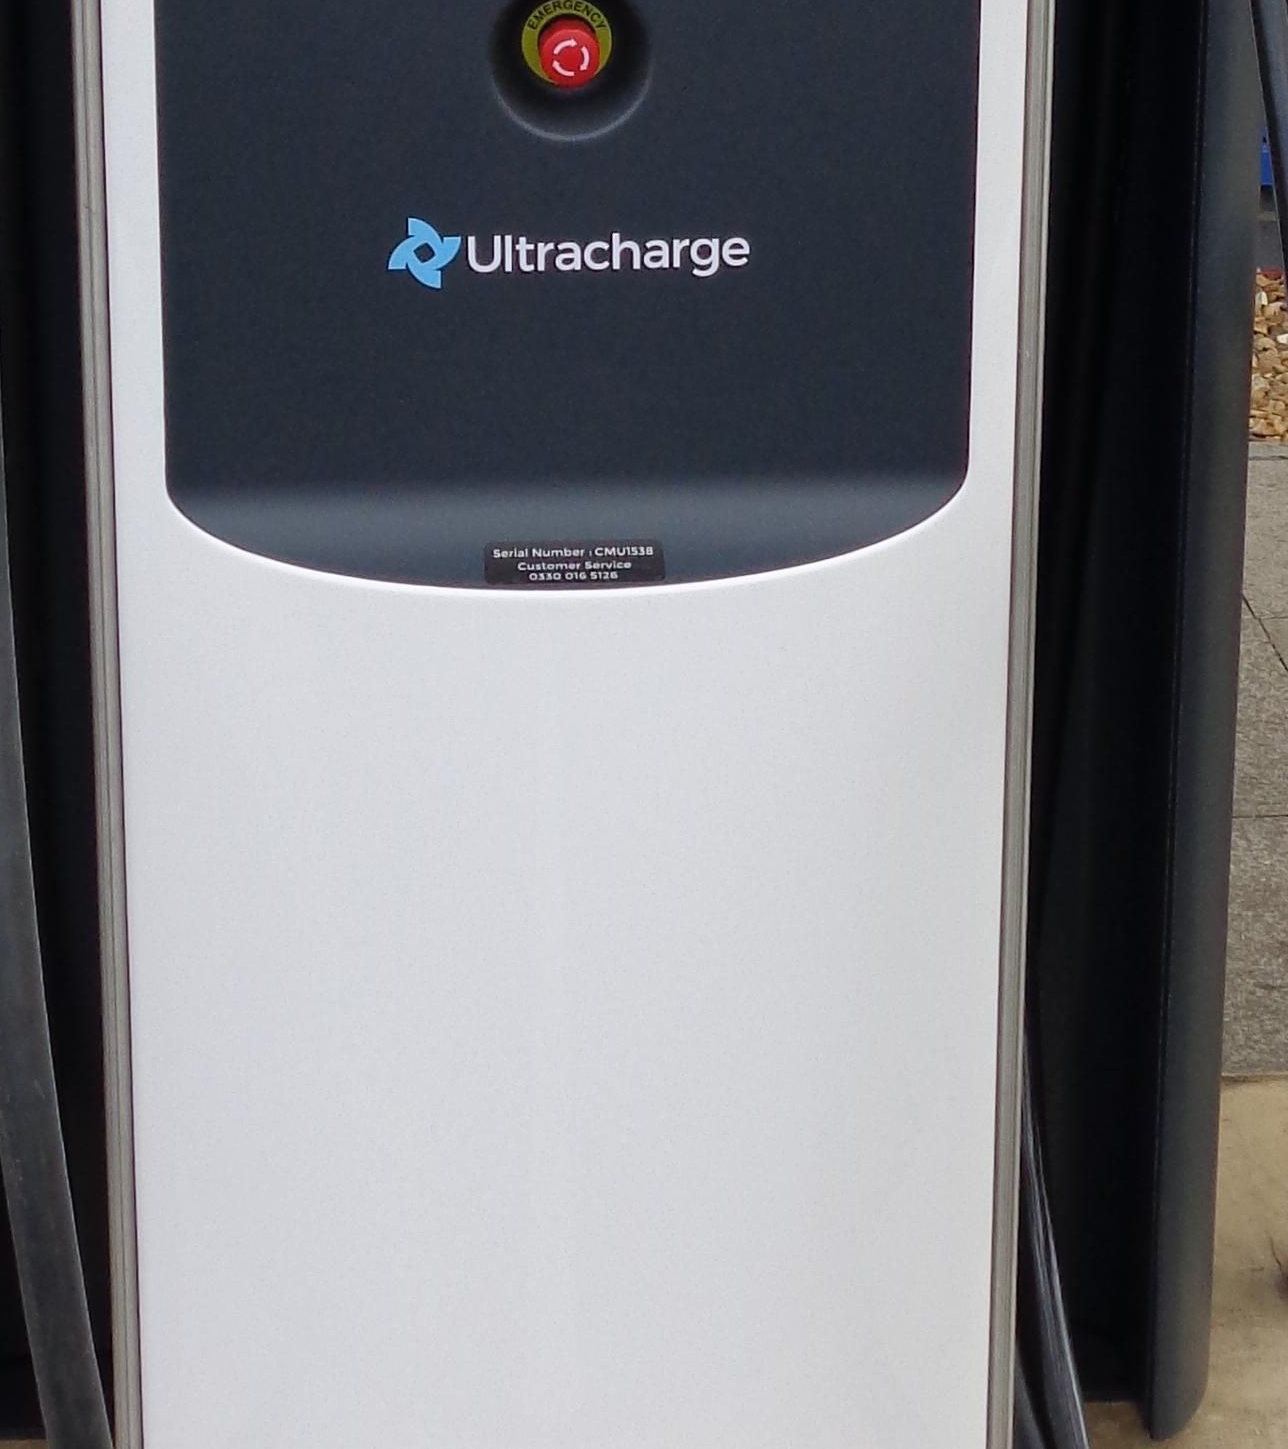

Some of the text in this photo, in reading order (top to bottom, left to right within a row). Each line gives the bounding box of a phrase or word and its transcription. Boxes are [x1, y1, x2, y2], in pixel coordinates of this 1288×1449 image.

[527, 0, 607, 31] EMERGENCY
[467, 233, 751, 277] Ultracharge
[493, 548, 529, 558] Serial
[532, 548, 585, 557] Number
[517, 560, 632, 571] Customer Service
[529, 571, 619, 581] 0330 016 5126
